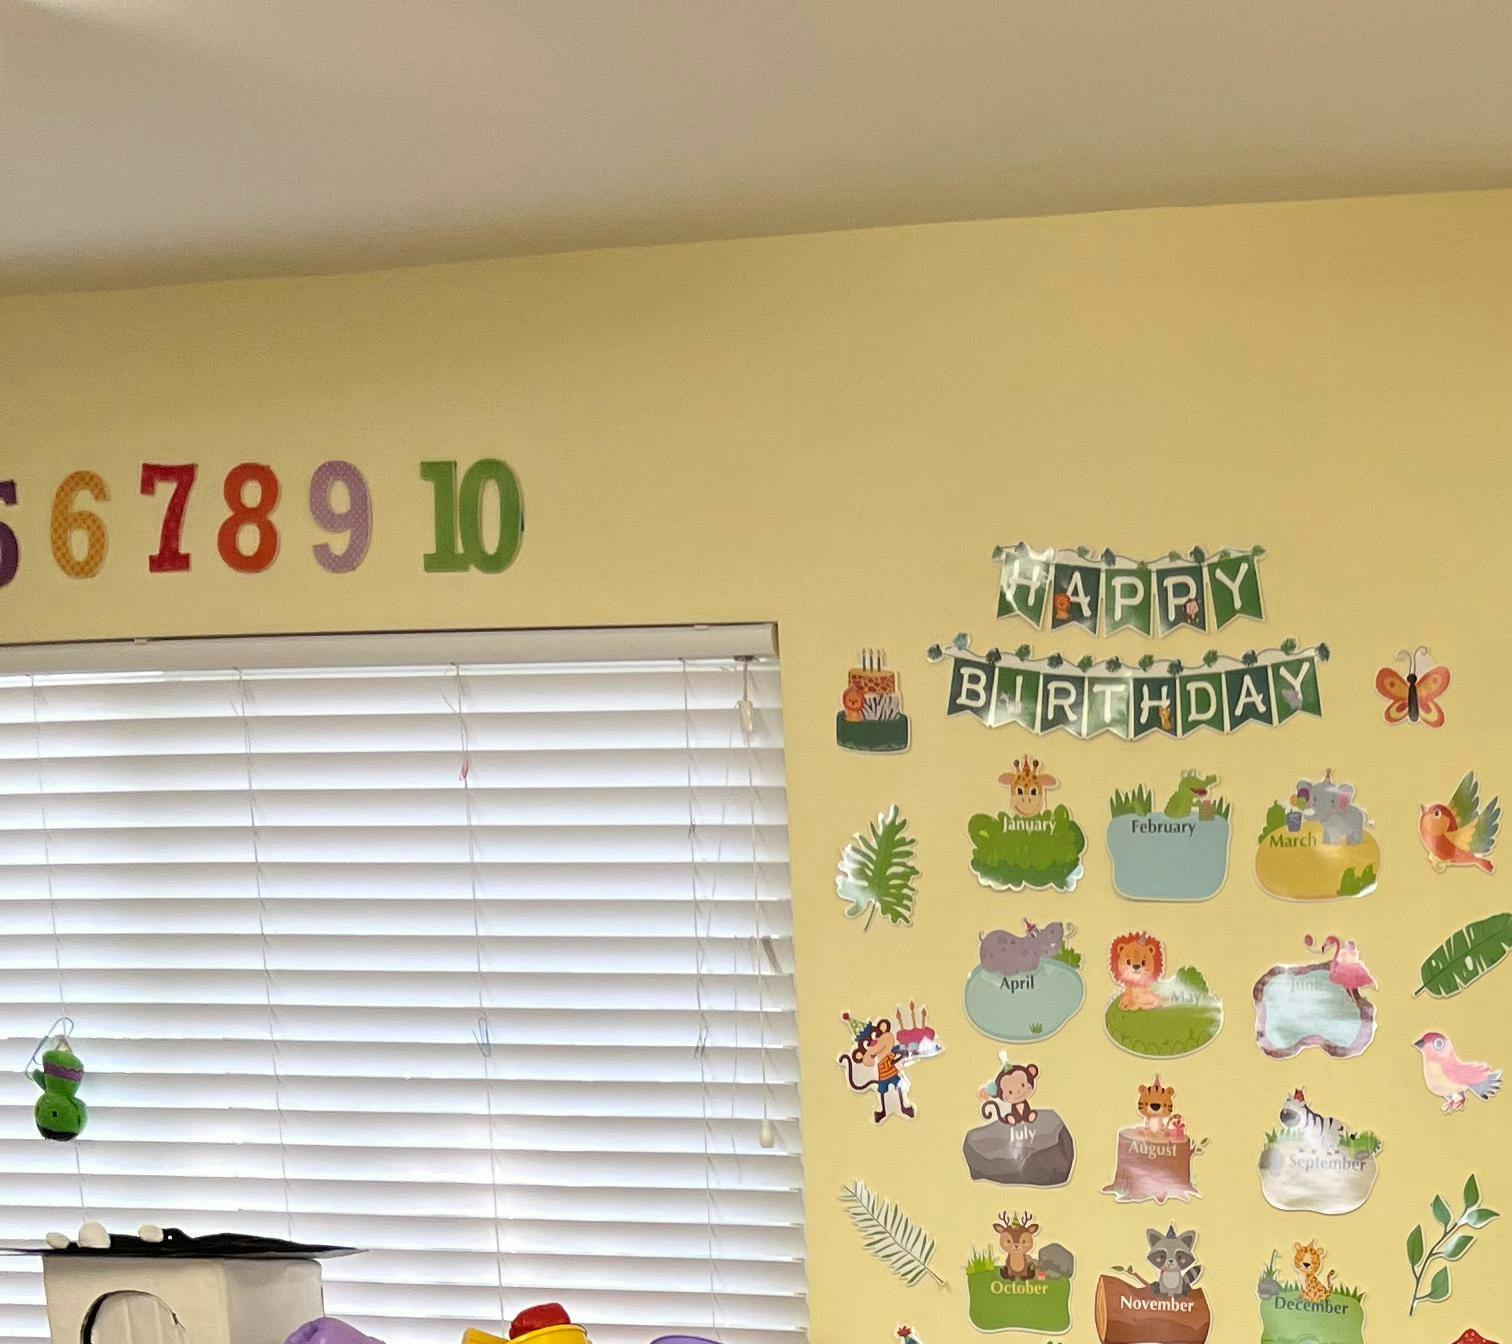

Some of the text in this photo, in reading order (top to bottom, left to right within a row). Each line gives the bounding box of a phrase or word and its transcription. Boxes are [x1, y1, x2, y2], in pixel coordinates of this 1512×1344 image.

[51, 470, 109, 578] 6
[140, 464, 198, 574] 7
[217, 462, 281, 574] 8
[309, 460, 372, 574] 9
[420, 459, 524, 574] 10
[1005, 559, 1249, 622] HAPPY
[955, 661, 1311, 724] BIRTHDAY
[1002, 816, 1057, 835] January
[1131, 819, 1197, 837] February
[1269, 832, 1317, 848] March
[1000, 976, 1035, 992] April
[1009, 1126, 1037, 1145] July
[1128, 1139, 1178, 1159] August
[1288, 1154, 1367, 1177] September
[990, 1280, 1049, 1296] October
[1120, 1295, 1194, 1314] November
[1274, 1296, 1350, 1316] December
